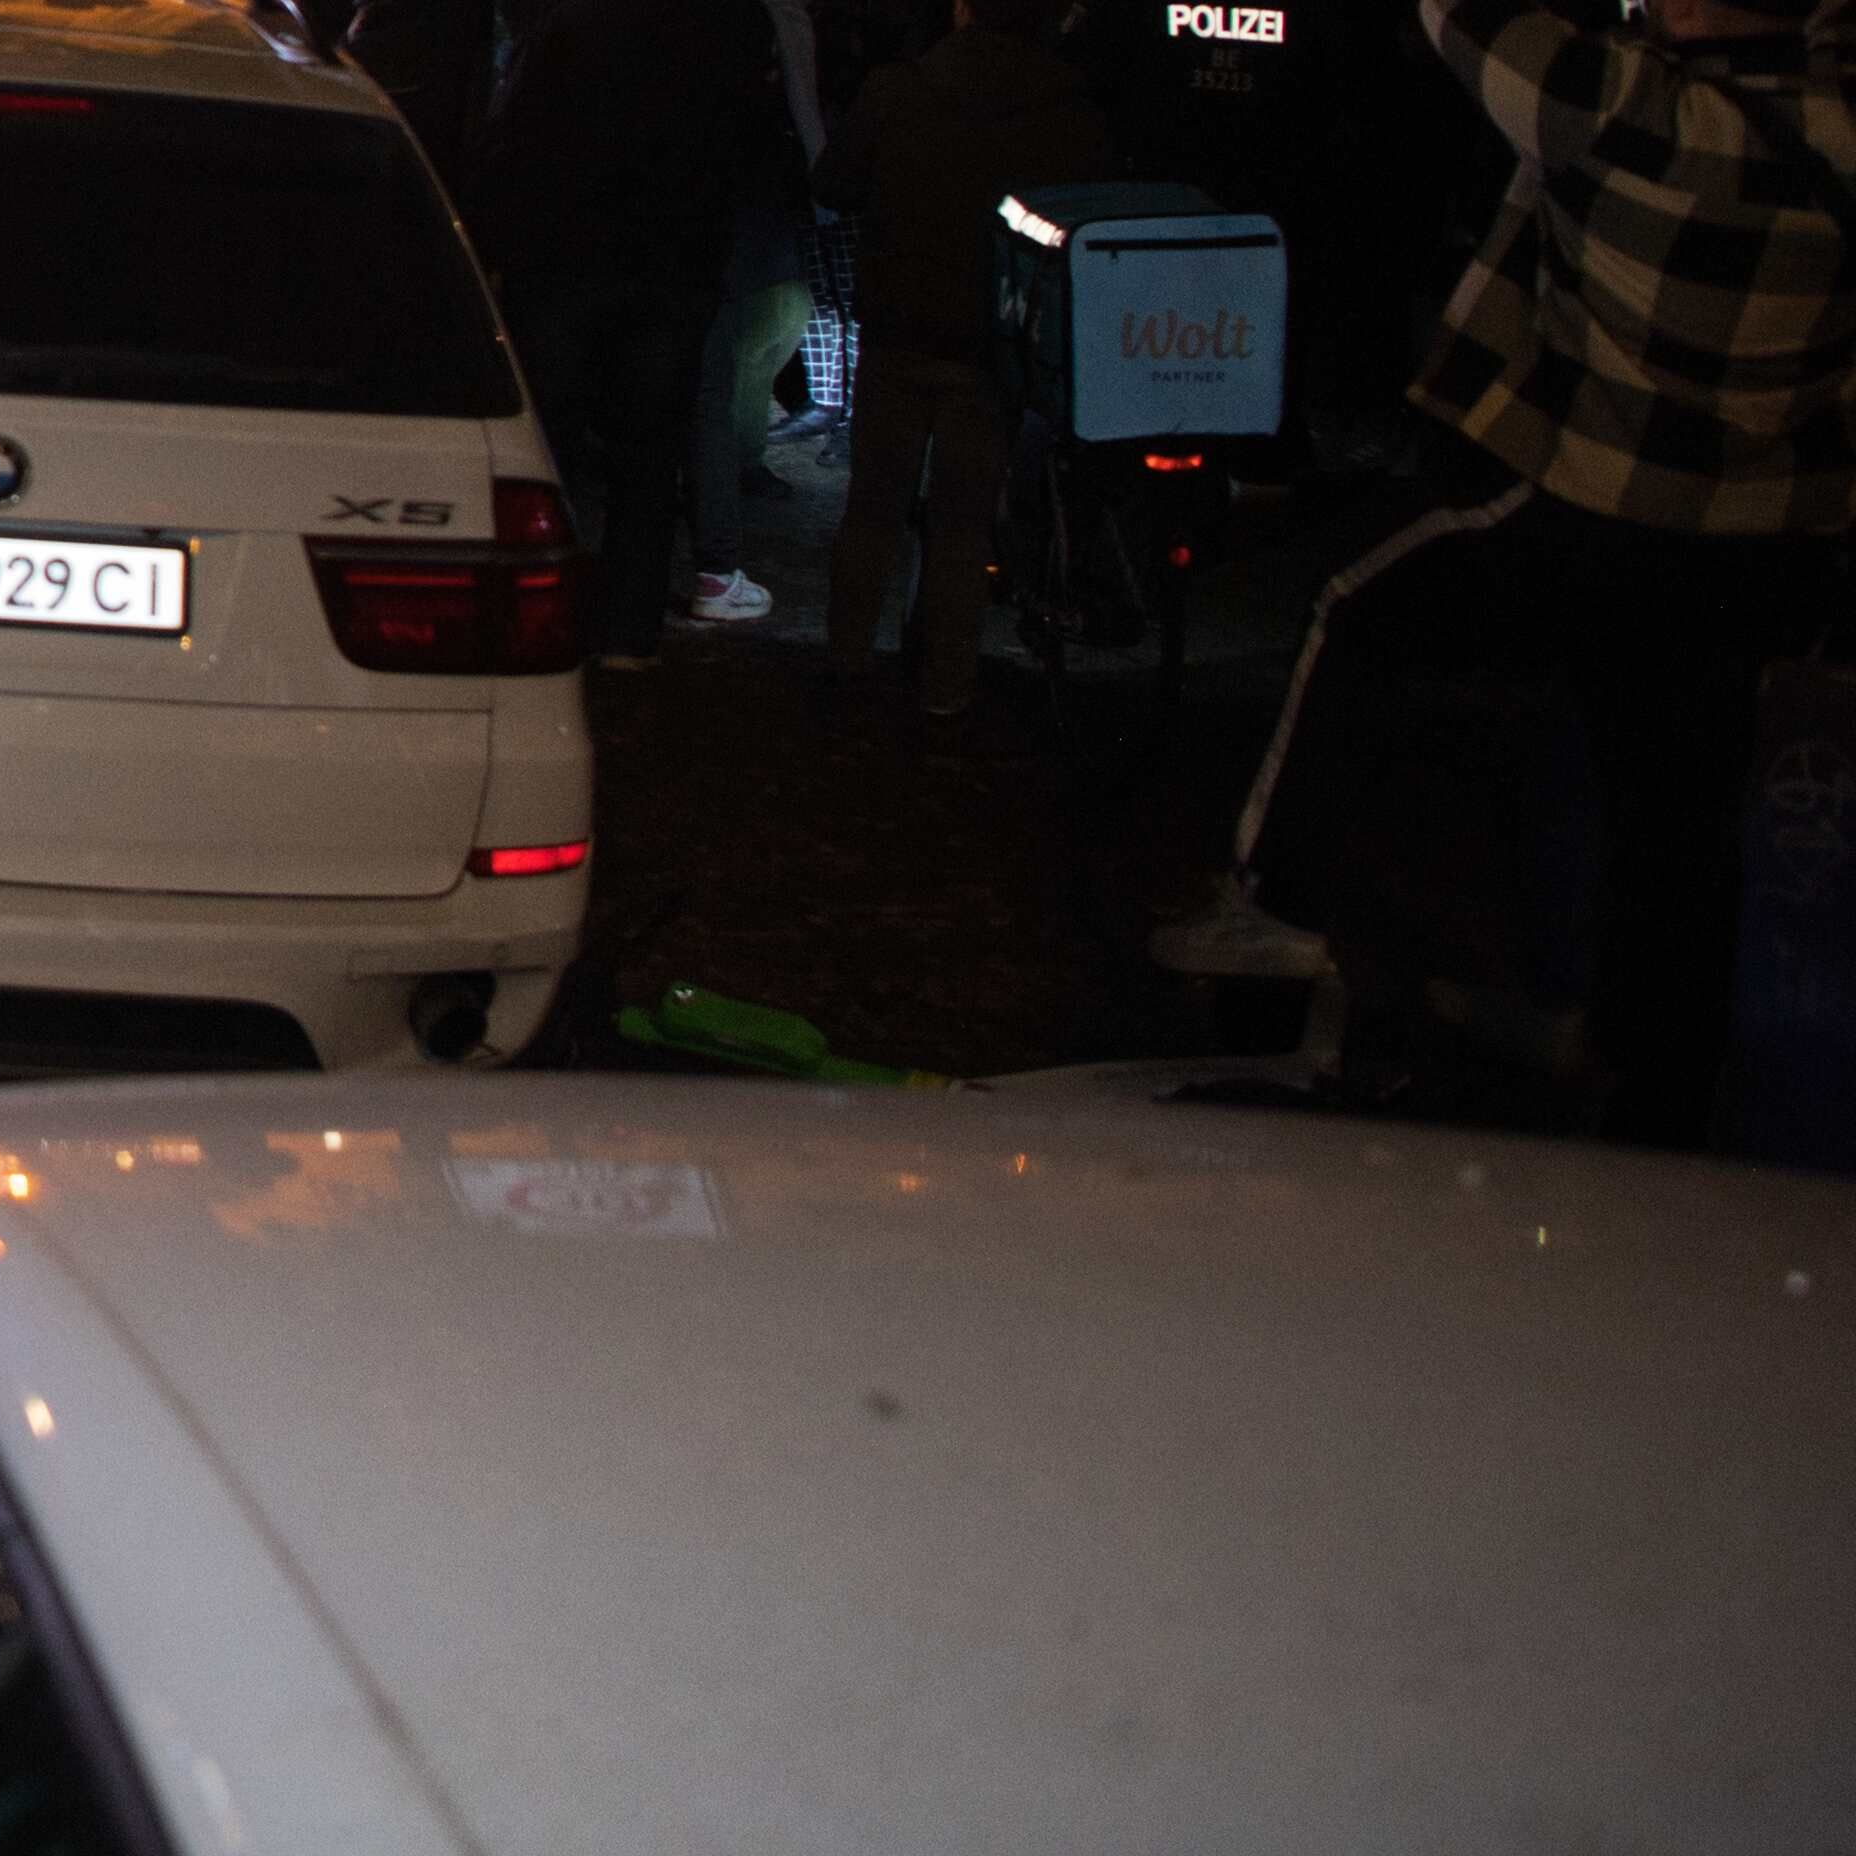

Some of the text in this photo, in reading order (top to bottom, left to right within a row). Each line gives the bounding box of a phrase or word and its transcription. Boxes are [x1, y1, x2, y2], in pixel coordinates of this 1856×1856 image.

[1165, 3, 1284, 44] POLIZEI
[1119, 305, 1256, 360] Wolt
[1150, 370, 1226, 384] PARTNER
[322, 495, 455, 525] X5
[92, 561, 159, 617] CI
